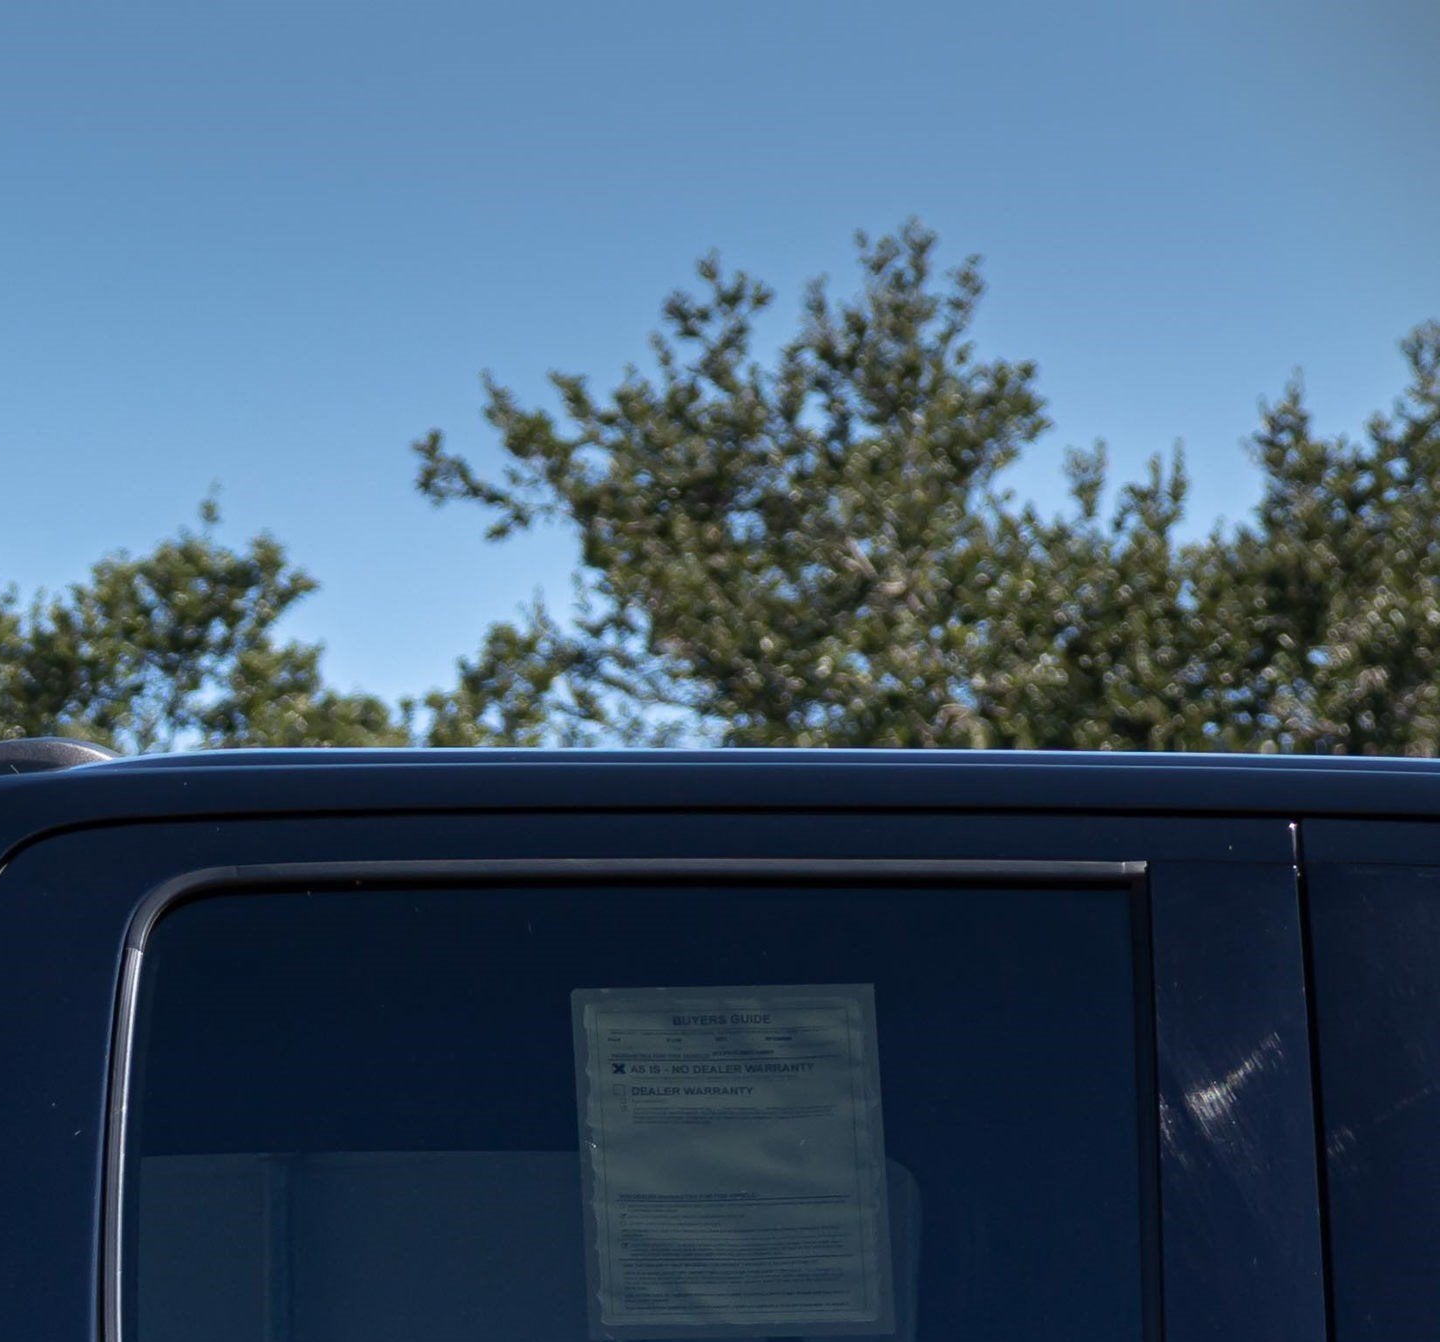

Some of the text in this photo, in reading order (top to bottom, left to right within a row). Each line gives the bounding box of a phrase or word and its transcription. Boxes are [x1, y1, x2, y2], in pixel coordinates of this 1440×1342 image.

[673, 1014, 772, 1026] BUYERS GUIDE
[631, 1064, 646, 1074] AS
[649, 1064, 660, 1074] IS
[672, 1064, 690, 1074] NO
[693, 1064, 742, 1074] DEALER
[745, 1063, 815, 1073] WARRANTY
[631, 1086, 753, 1096] DEALER WARRANTY
